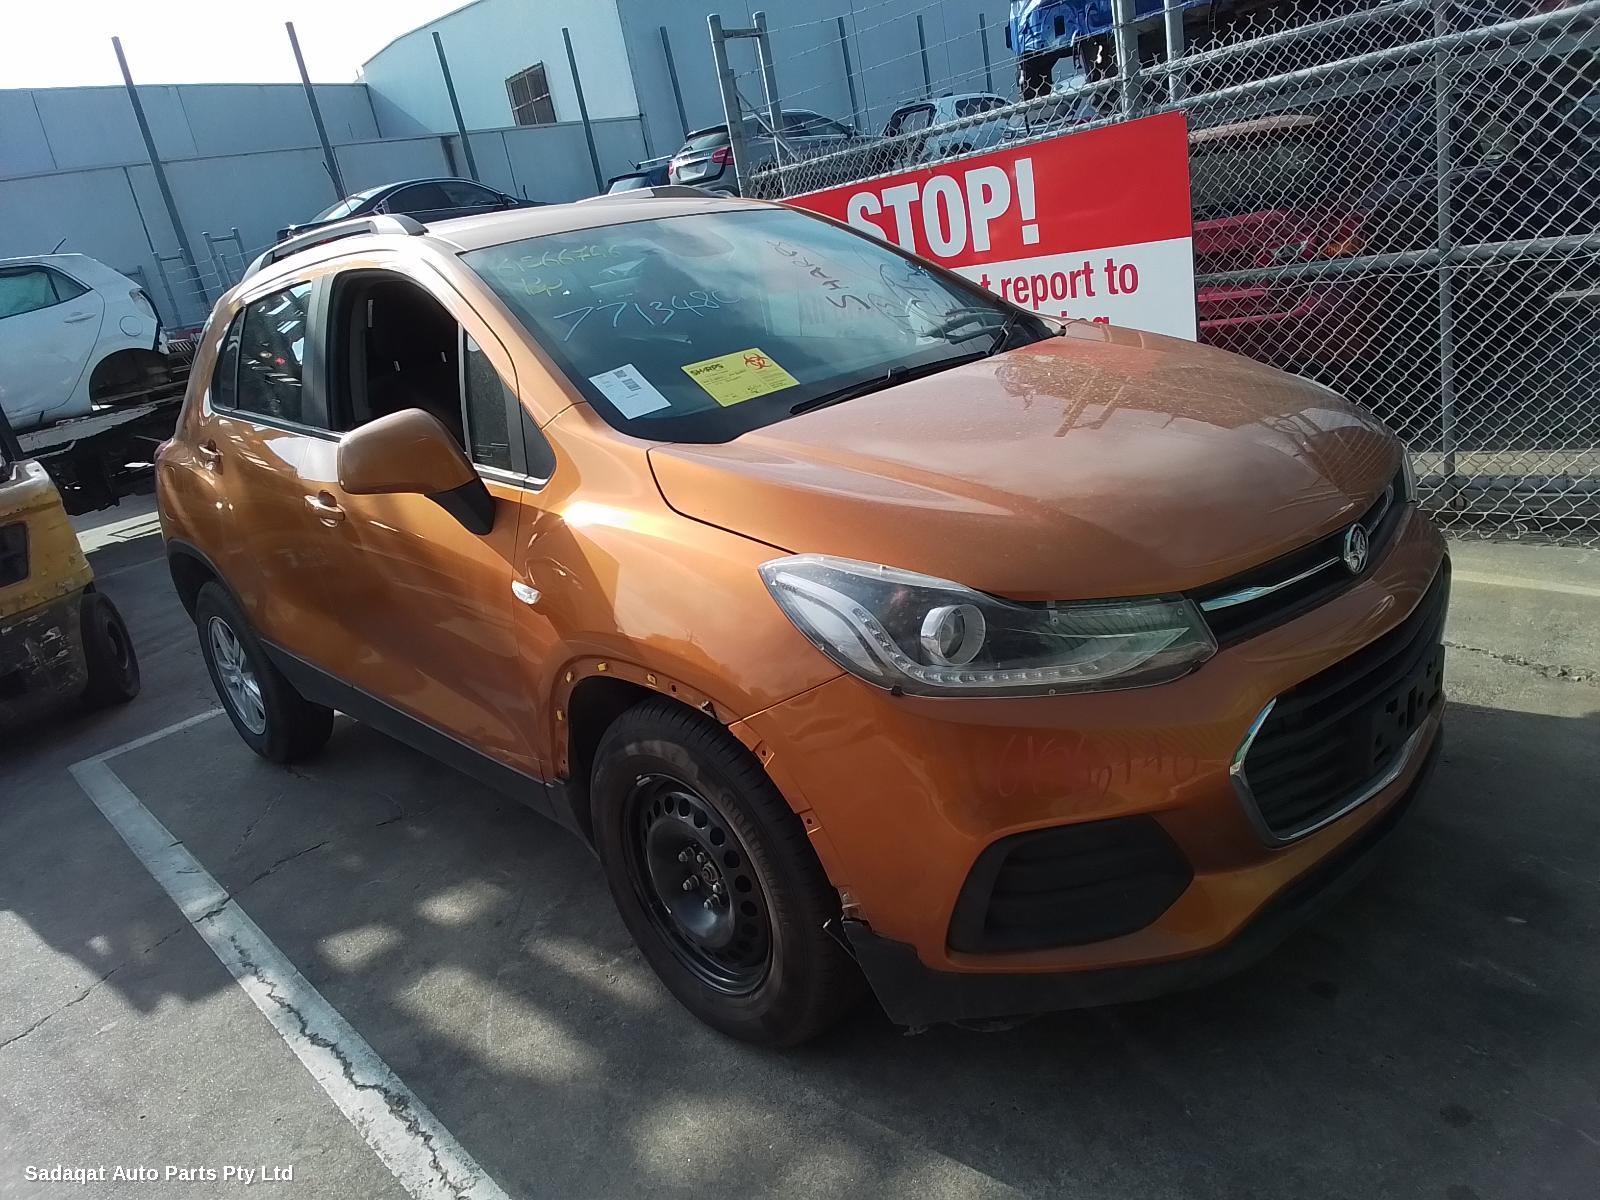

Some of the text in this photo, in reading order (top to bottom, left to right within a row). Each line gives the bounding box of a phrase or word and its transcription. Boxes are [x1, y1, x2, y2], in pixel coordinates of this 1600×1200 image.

[847, 157, 1040, 258] STOP!
[1001, 261, 1096, 311] report
[1104, 258, 1139, 296] to
